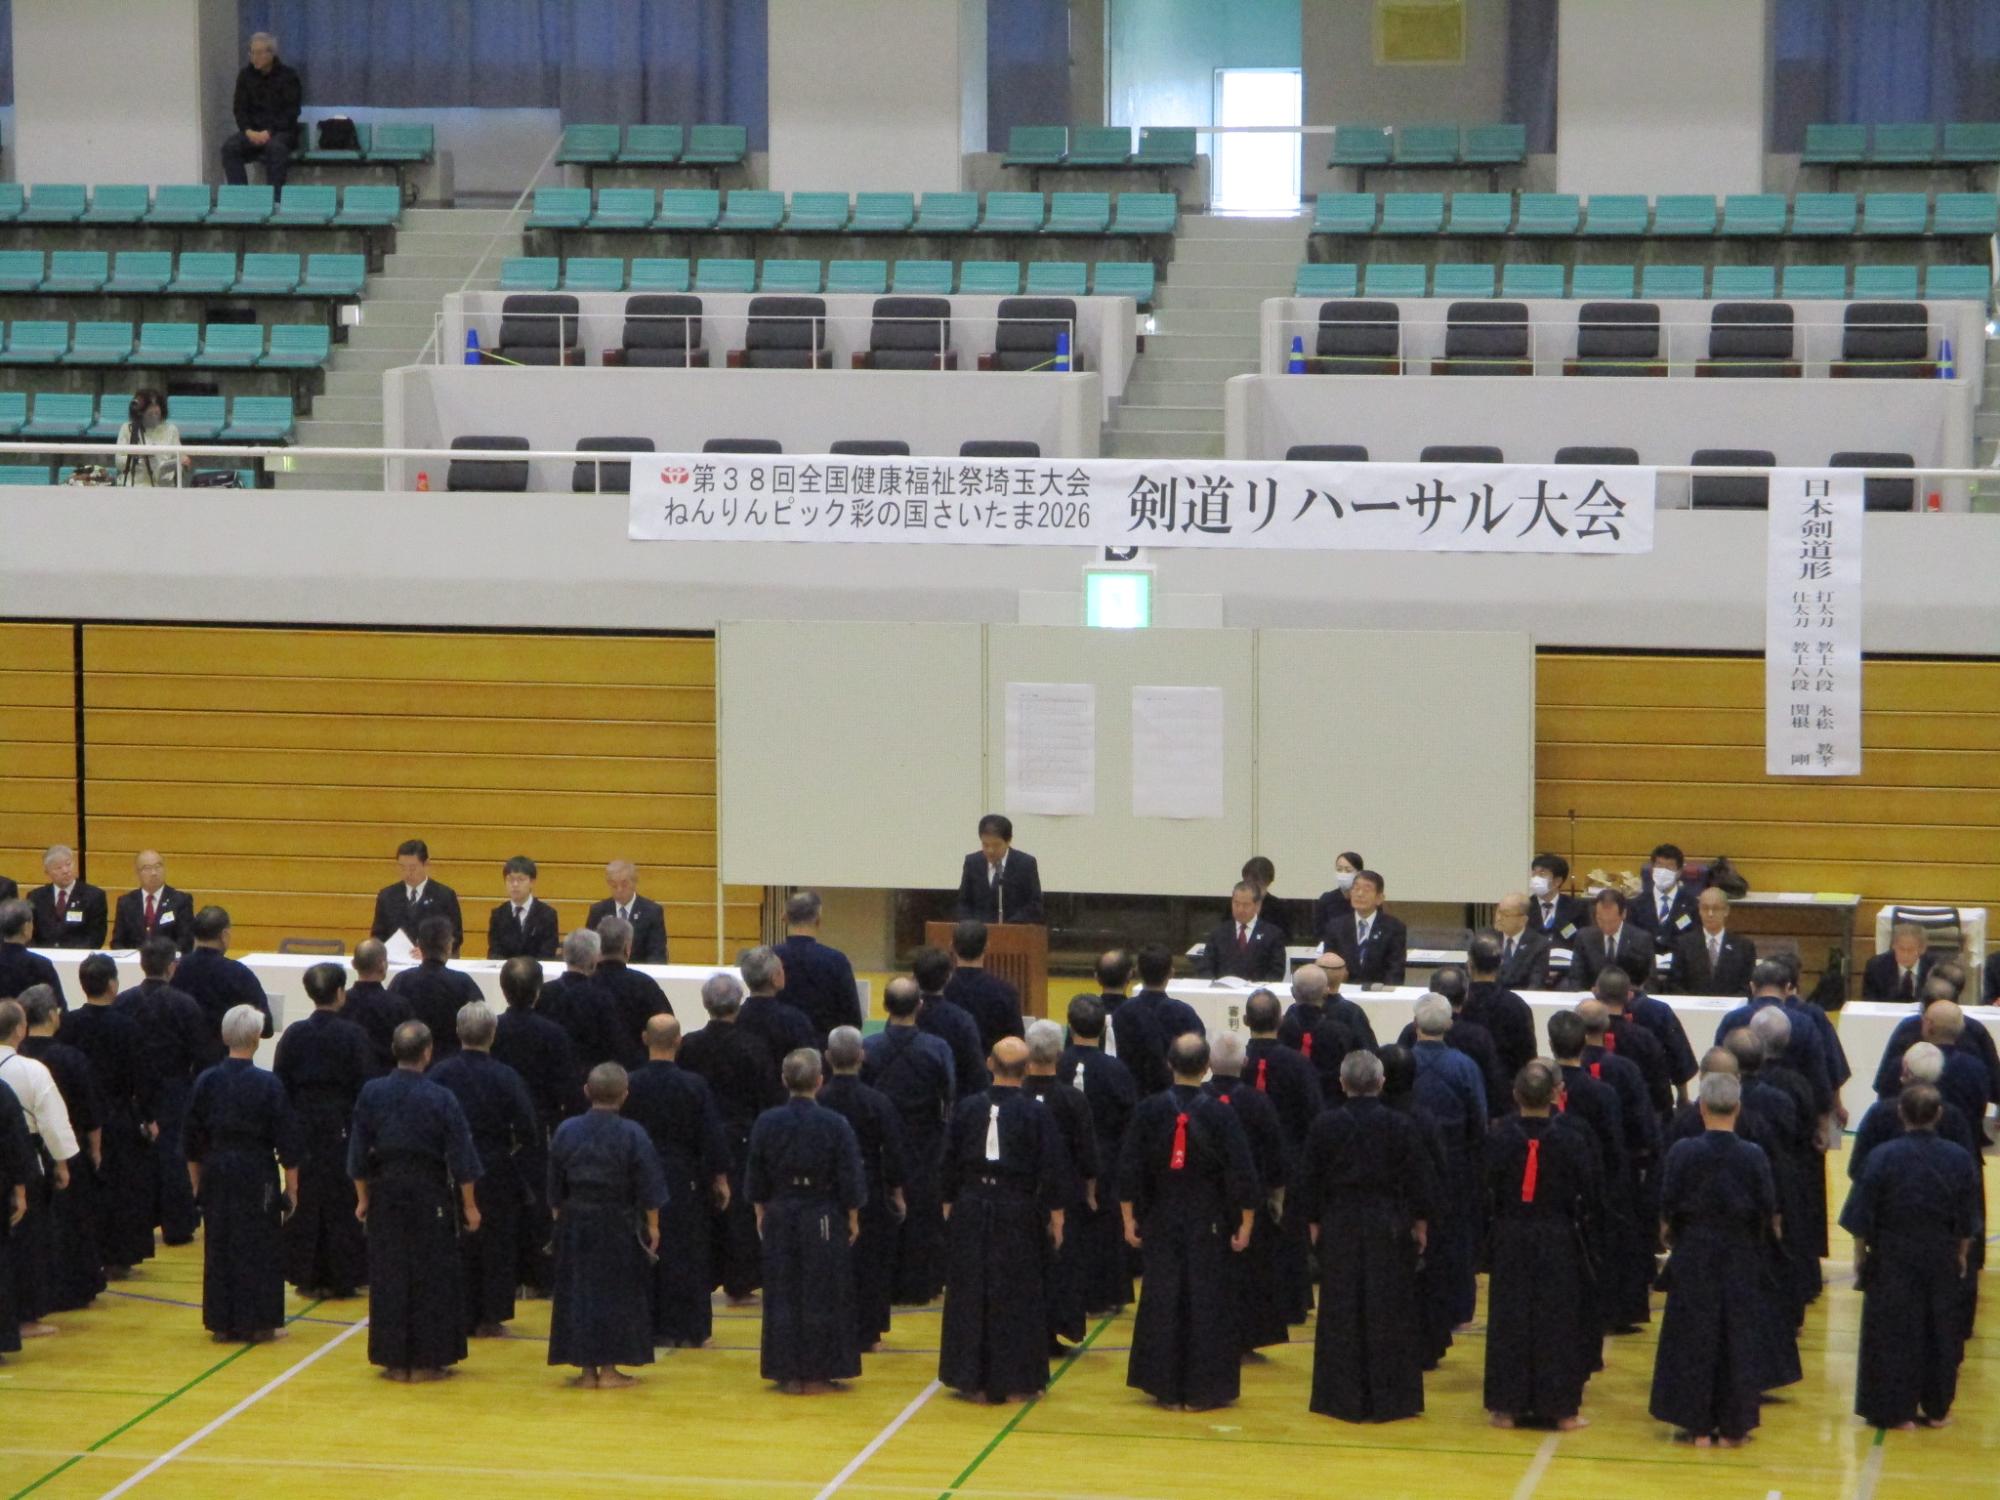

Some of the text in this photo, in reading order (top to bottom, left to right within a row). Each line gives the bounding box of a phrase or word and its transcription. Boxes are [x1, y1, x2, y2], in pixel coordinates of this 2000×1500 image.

[692, 464, 1091, 498] 第38回全国健康福祉祭埼玉大会
[1127, 472, 1627, 542] 剣道リハーサル大会
[663, 496, 1091, 530] ねんりんピック彩の国さいたま2026
[1800, 479, 1834, 580] 日本剣道形
